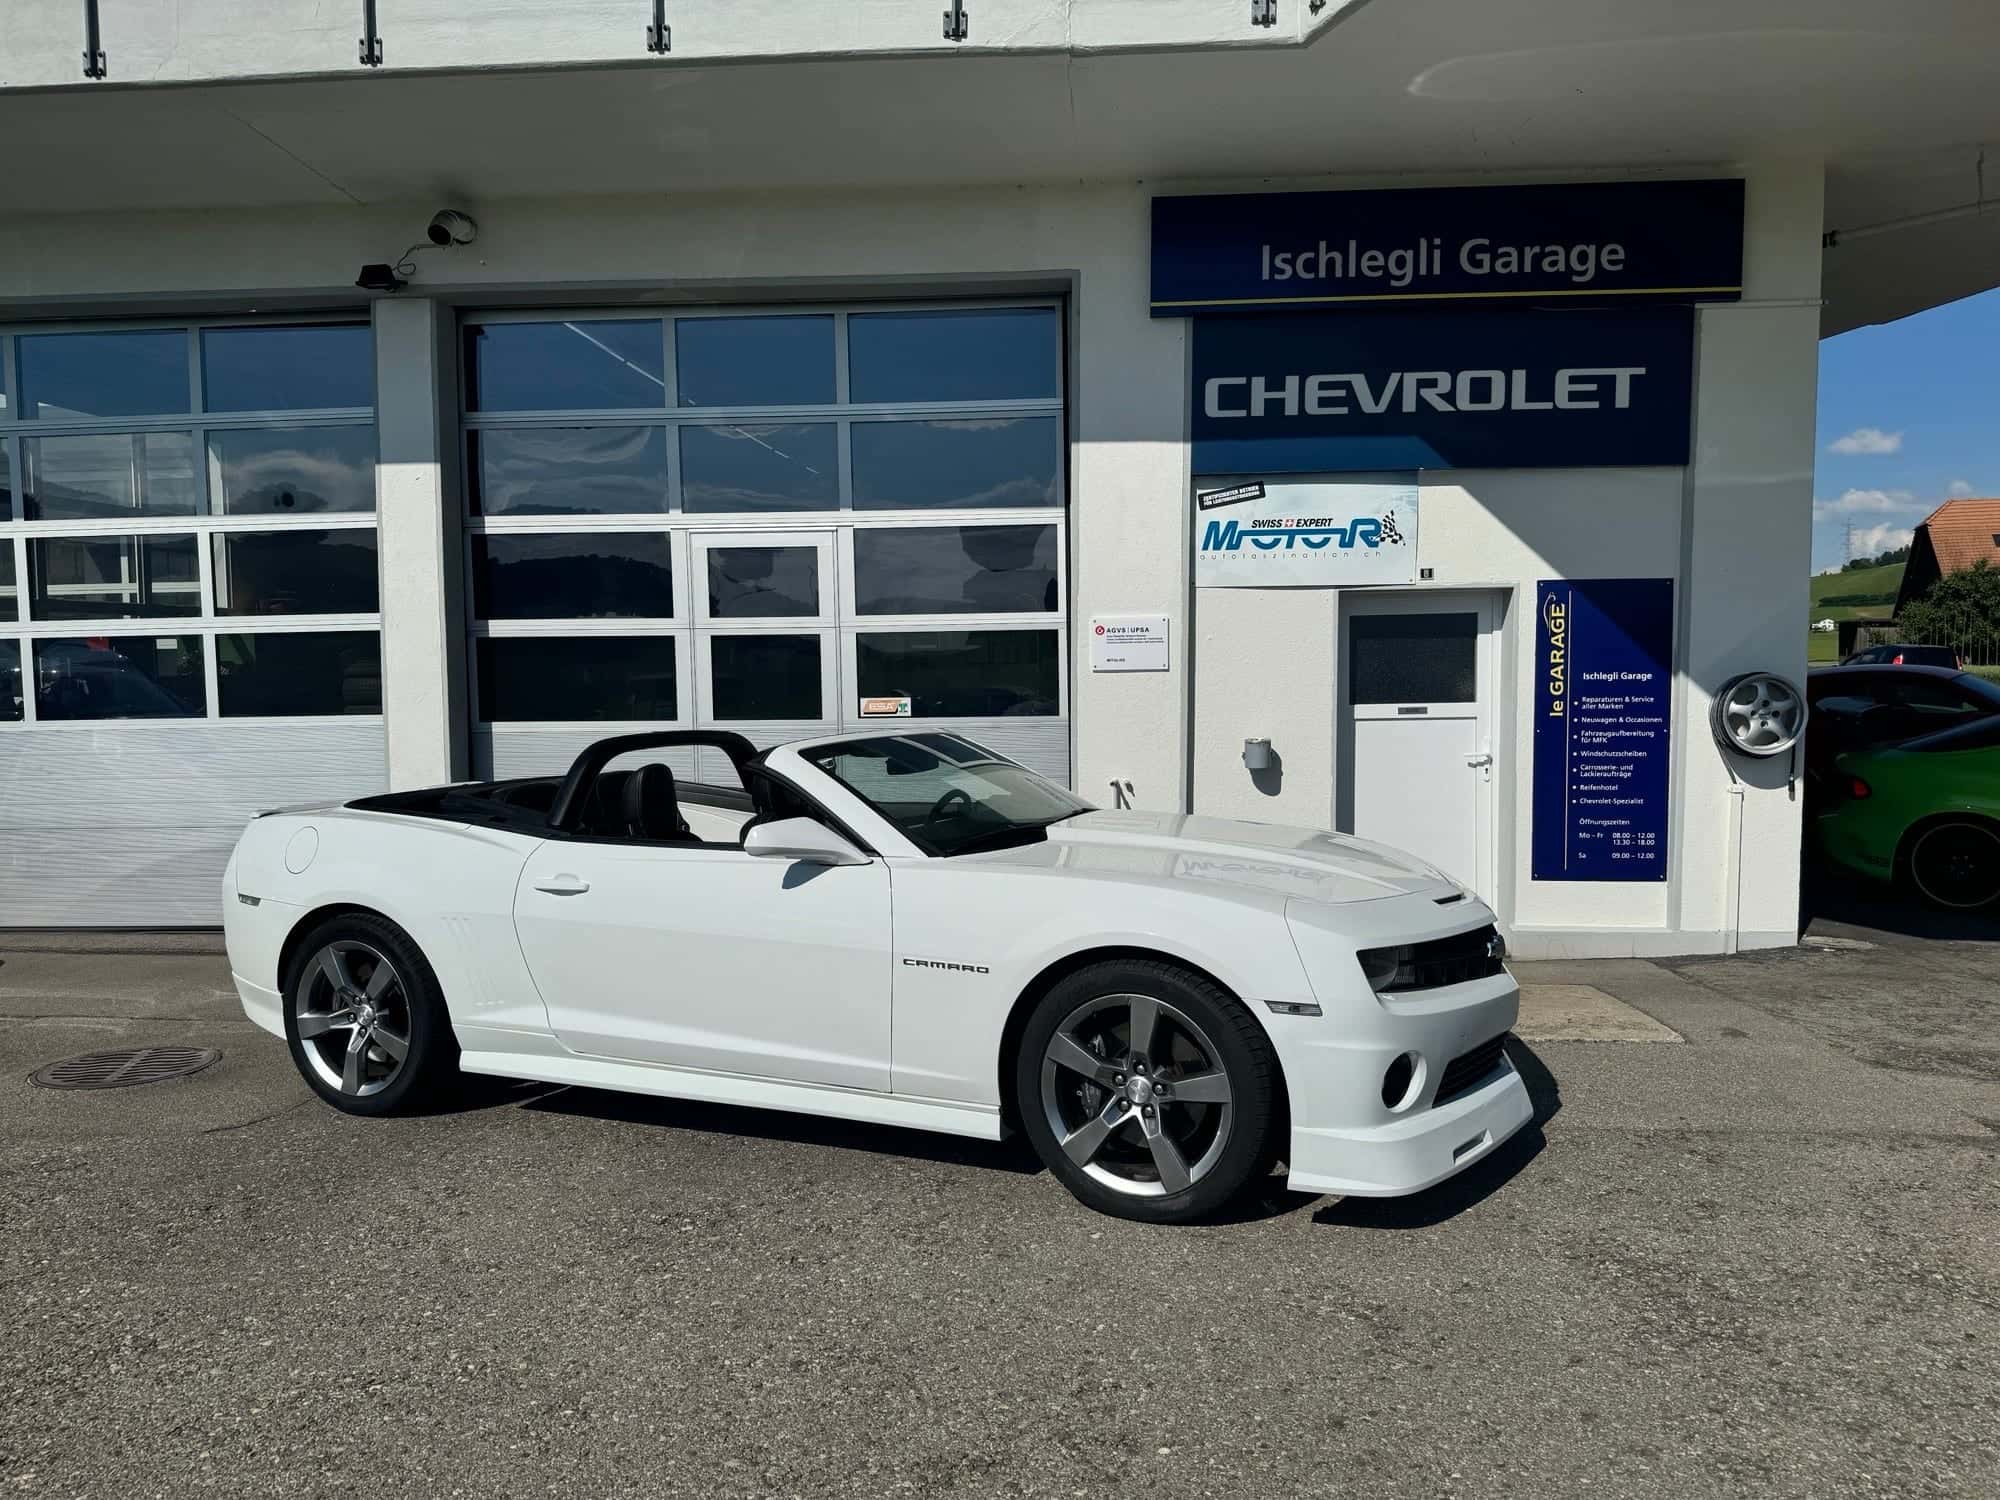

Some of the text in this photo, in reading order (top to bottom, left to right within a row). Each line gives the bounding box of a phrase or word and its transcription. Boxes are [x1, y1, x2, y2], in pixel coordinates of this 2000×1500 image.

[1261, 237, 1626, 286] Ischlegli Garage
[1204, 366, 1647, 418] CHEVROLET
[1251, 517, 1334, 528] SWISS EXPERT
[1549, 603, 1566, 717] le GARAGE
[1583, 672, 1653, 682] Ischlegli Garage
[1581, 696, 1623, 704] Reparaturen
[1581, 730, 1655, 738] Fahrzeugaufbereitung
[1579, 818, 1630, 826] Öffnungszeiten
[902, 958, 990, 974] CAMARO
